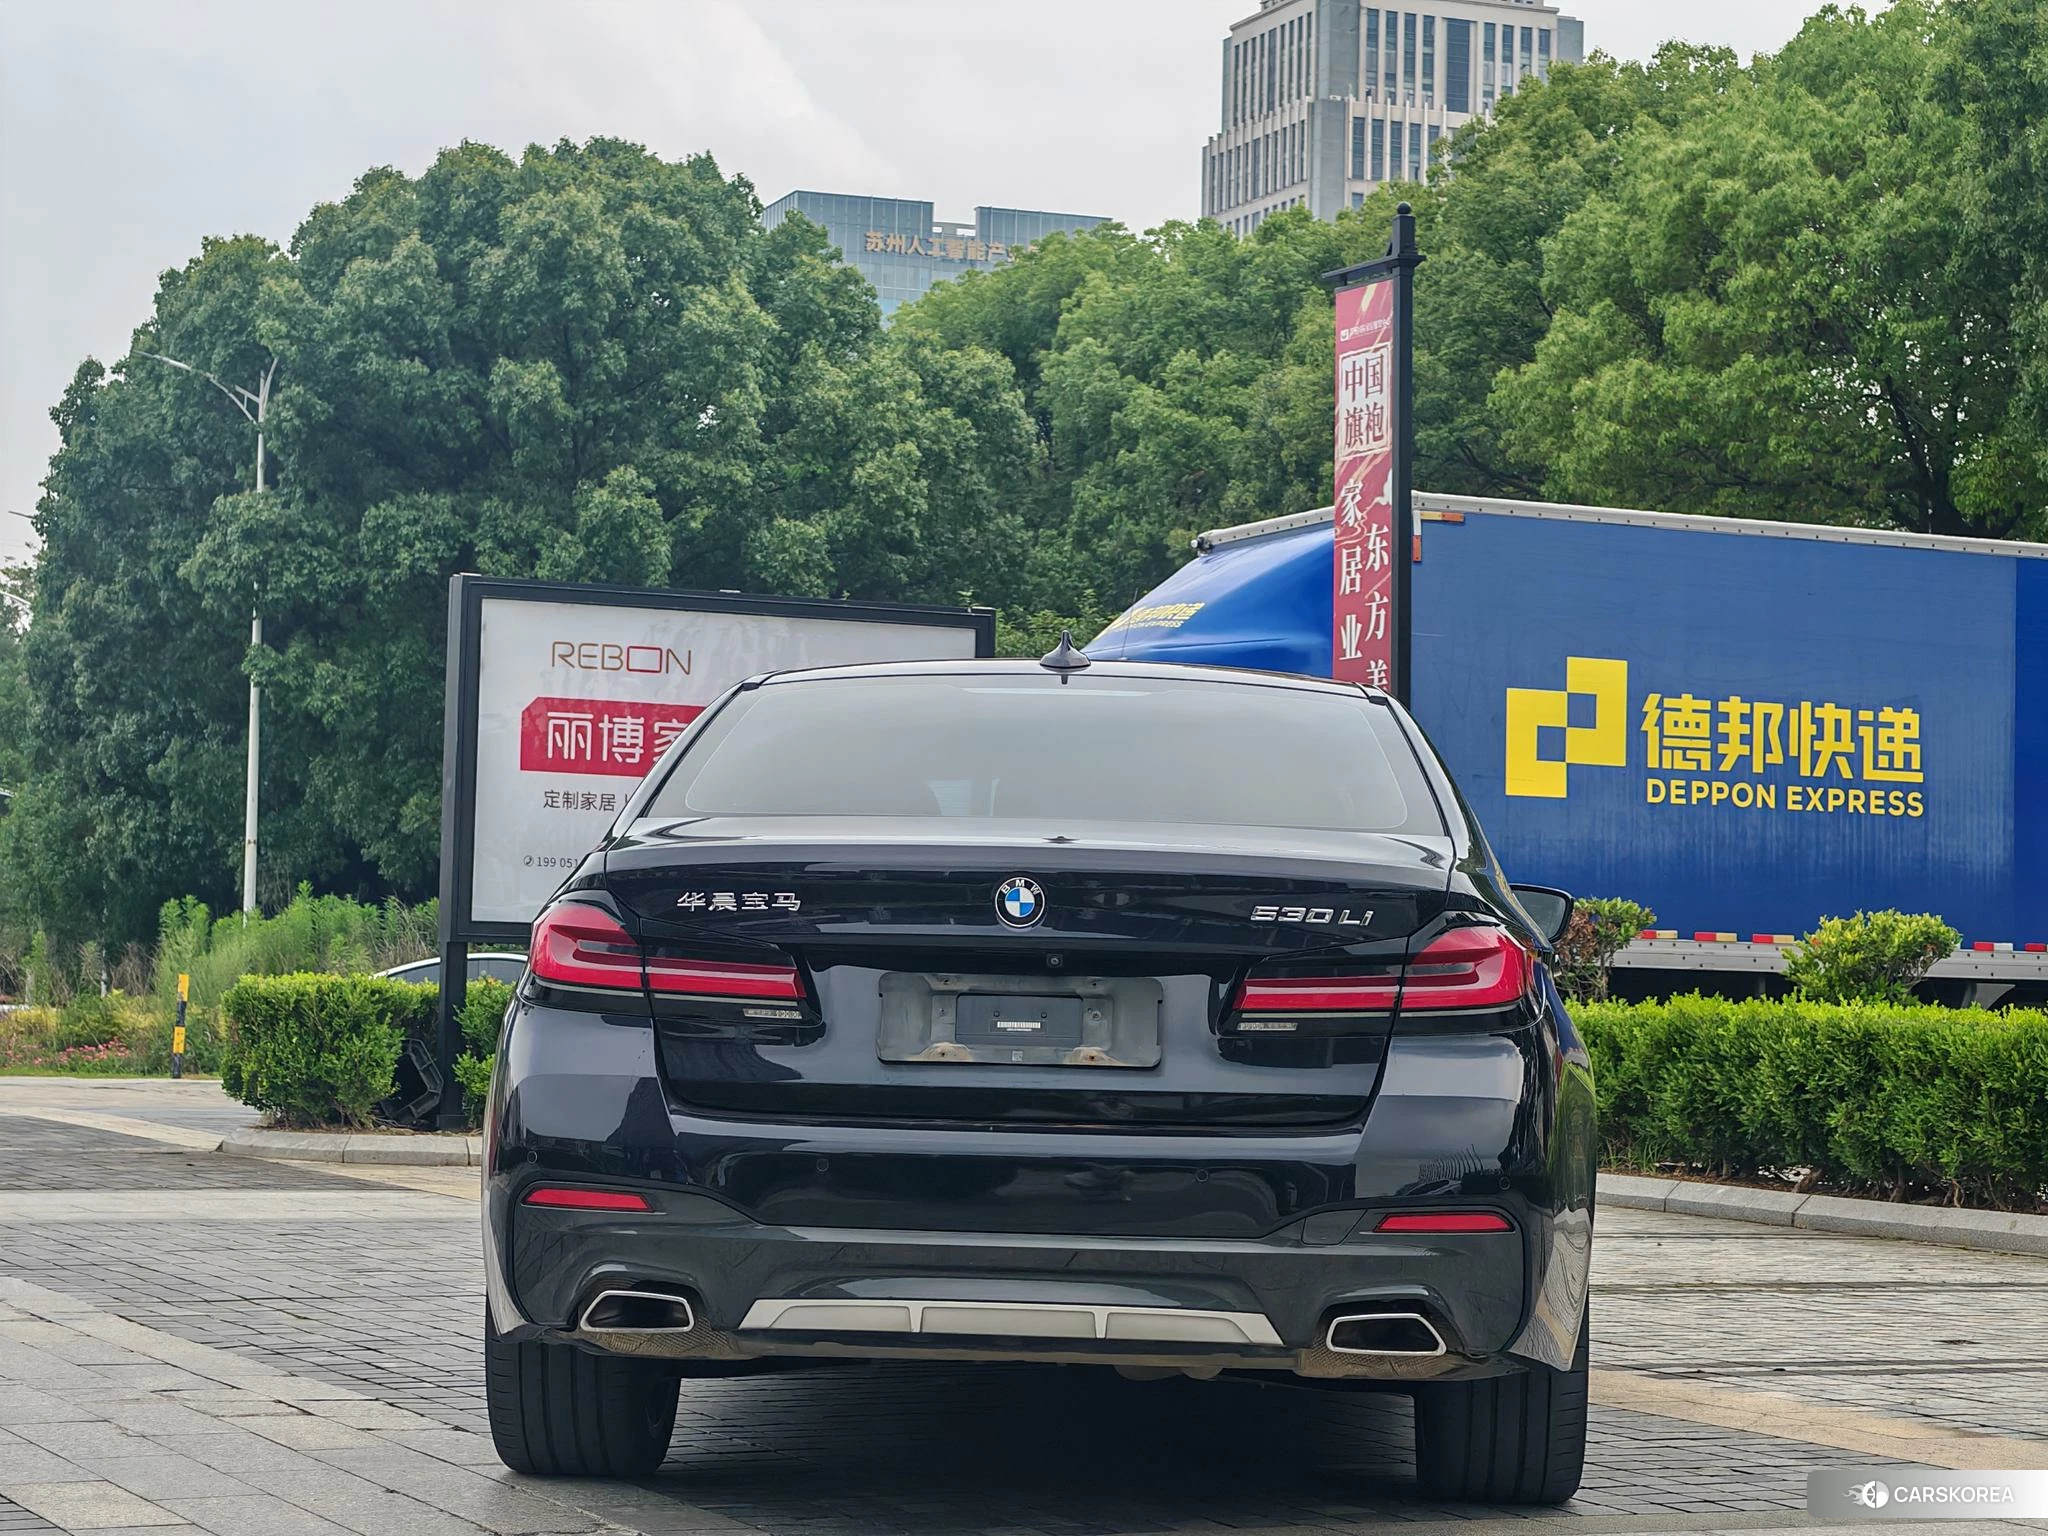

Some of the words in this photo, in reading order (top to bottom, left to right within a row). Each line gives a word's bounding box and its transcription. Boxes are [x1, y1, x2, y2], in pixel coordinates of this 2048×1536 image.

[864, 231, 1039, 263] 苏州人工智能产
[1345, 354, 1384, 402] 中国
[1344, 402, 1384, 449] 旗袍
[551, 640, 692, 675] REBON
[1640, 693, 1924, 783] 德邦快递
[543, 790, 617, 812] 定制家居
[1646, 778, 1776, 809] DEPPON
[1787, 785, 1925, 818] EXPRESS
[536, 856, 556, 868] 199
[677, 891, 801, 912] 华晨宝马
